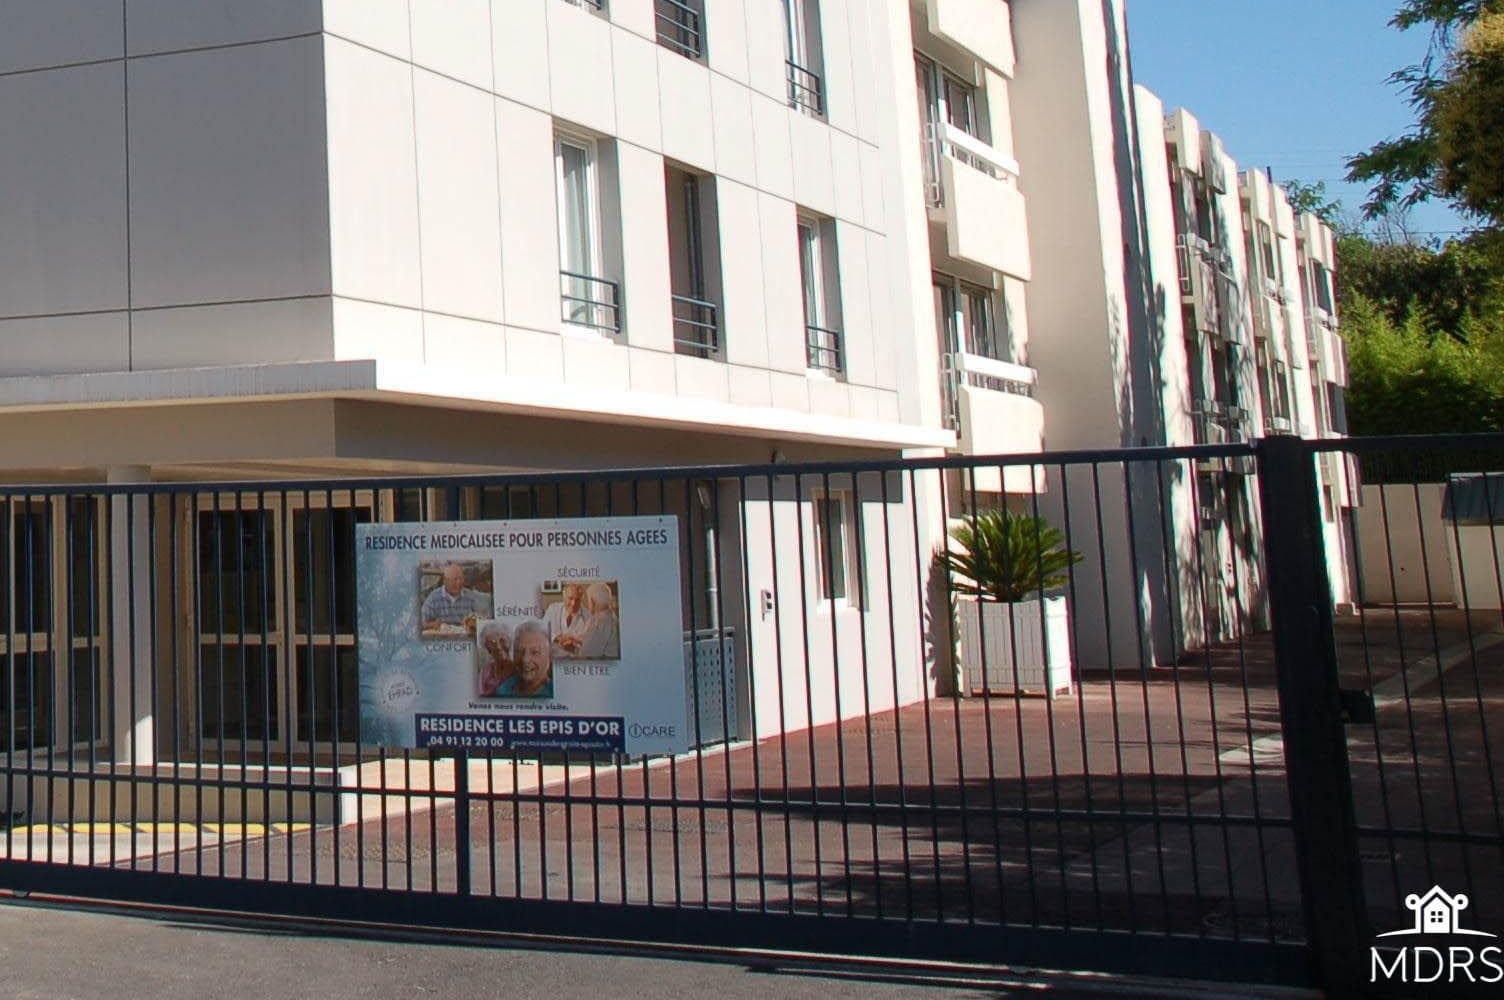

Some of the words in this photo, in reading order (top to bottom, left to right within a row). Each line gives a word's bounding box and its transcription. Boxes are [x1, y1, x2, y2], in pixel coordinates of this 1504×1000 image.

[365, 535, 427, 550] RESIDENCE
[430, 533, 505, 549] MEDICALISEE
[509, 532, 544, 547] POUR
[547, 530, 622, 547] PERSONNES
[626, 529, 668, 545] AGEES
[420, 718, 504, 733] RESIDENCE
[509, 719, 535, 734] LES
[540, 720, 573, 735] EPIS
[579, 720, 620, 736] D'OR
[430, 736, 443, 745] 04
[446, 736, 457, 746] 91
[461, 736, 472, 746] 12
[475, 737, 488, 747] 20
[490, 737, 504, 747] 00
